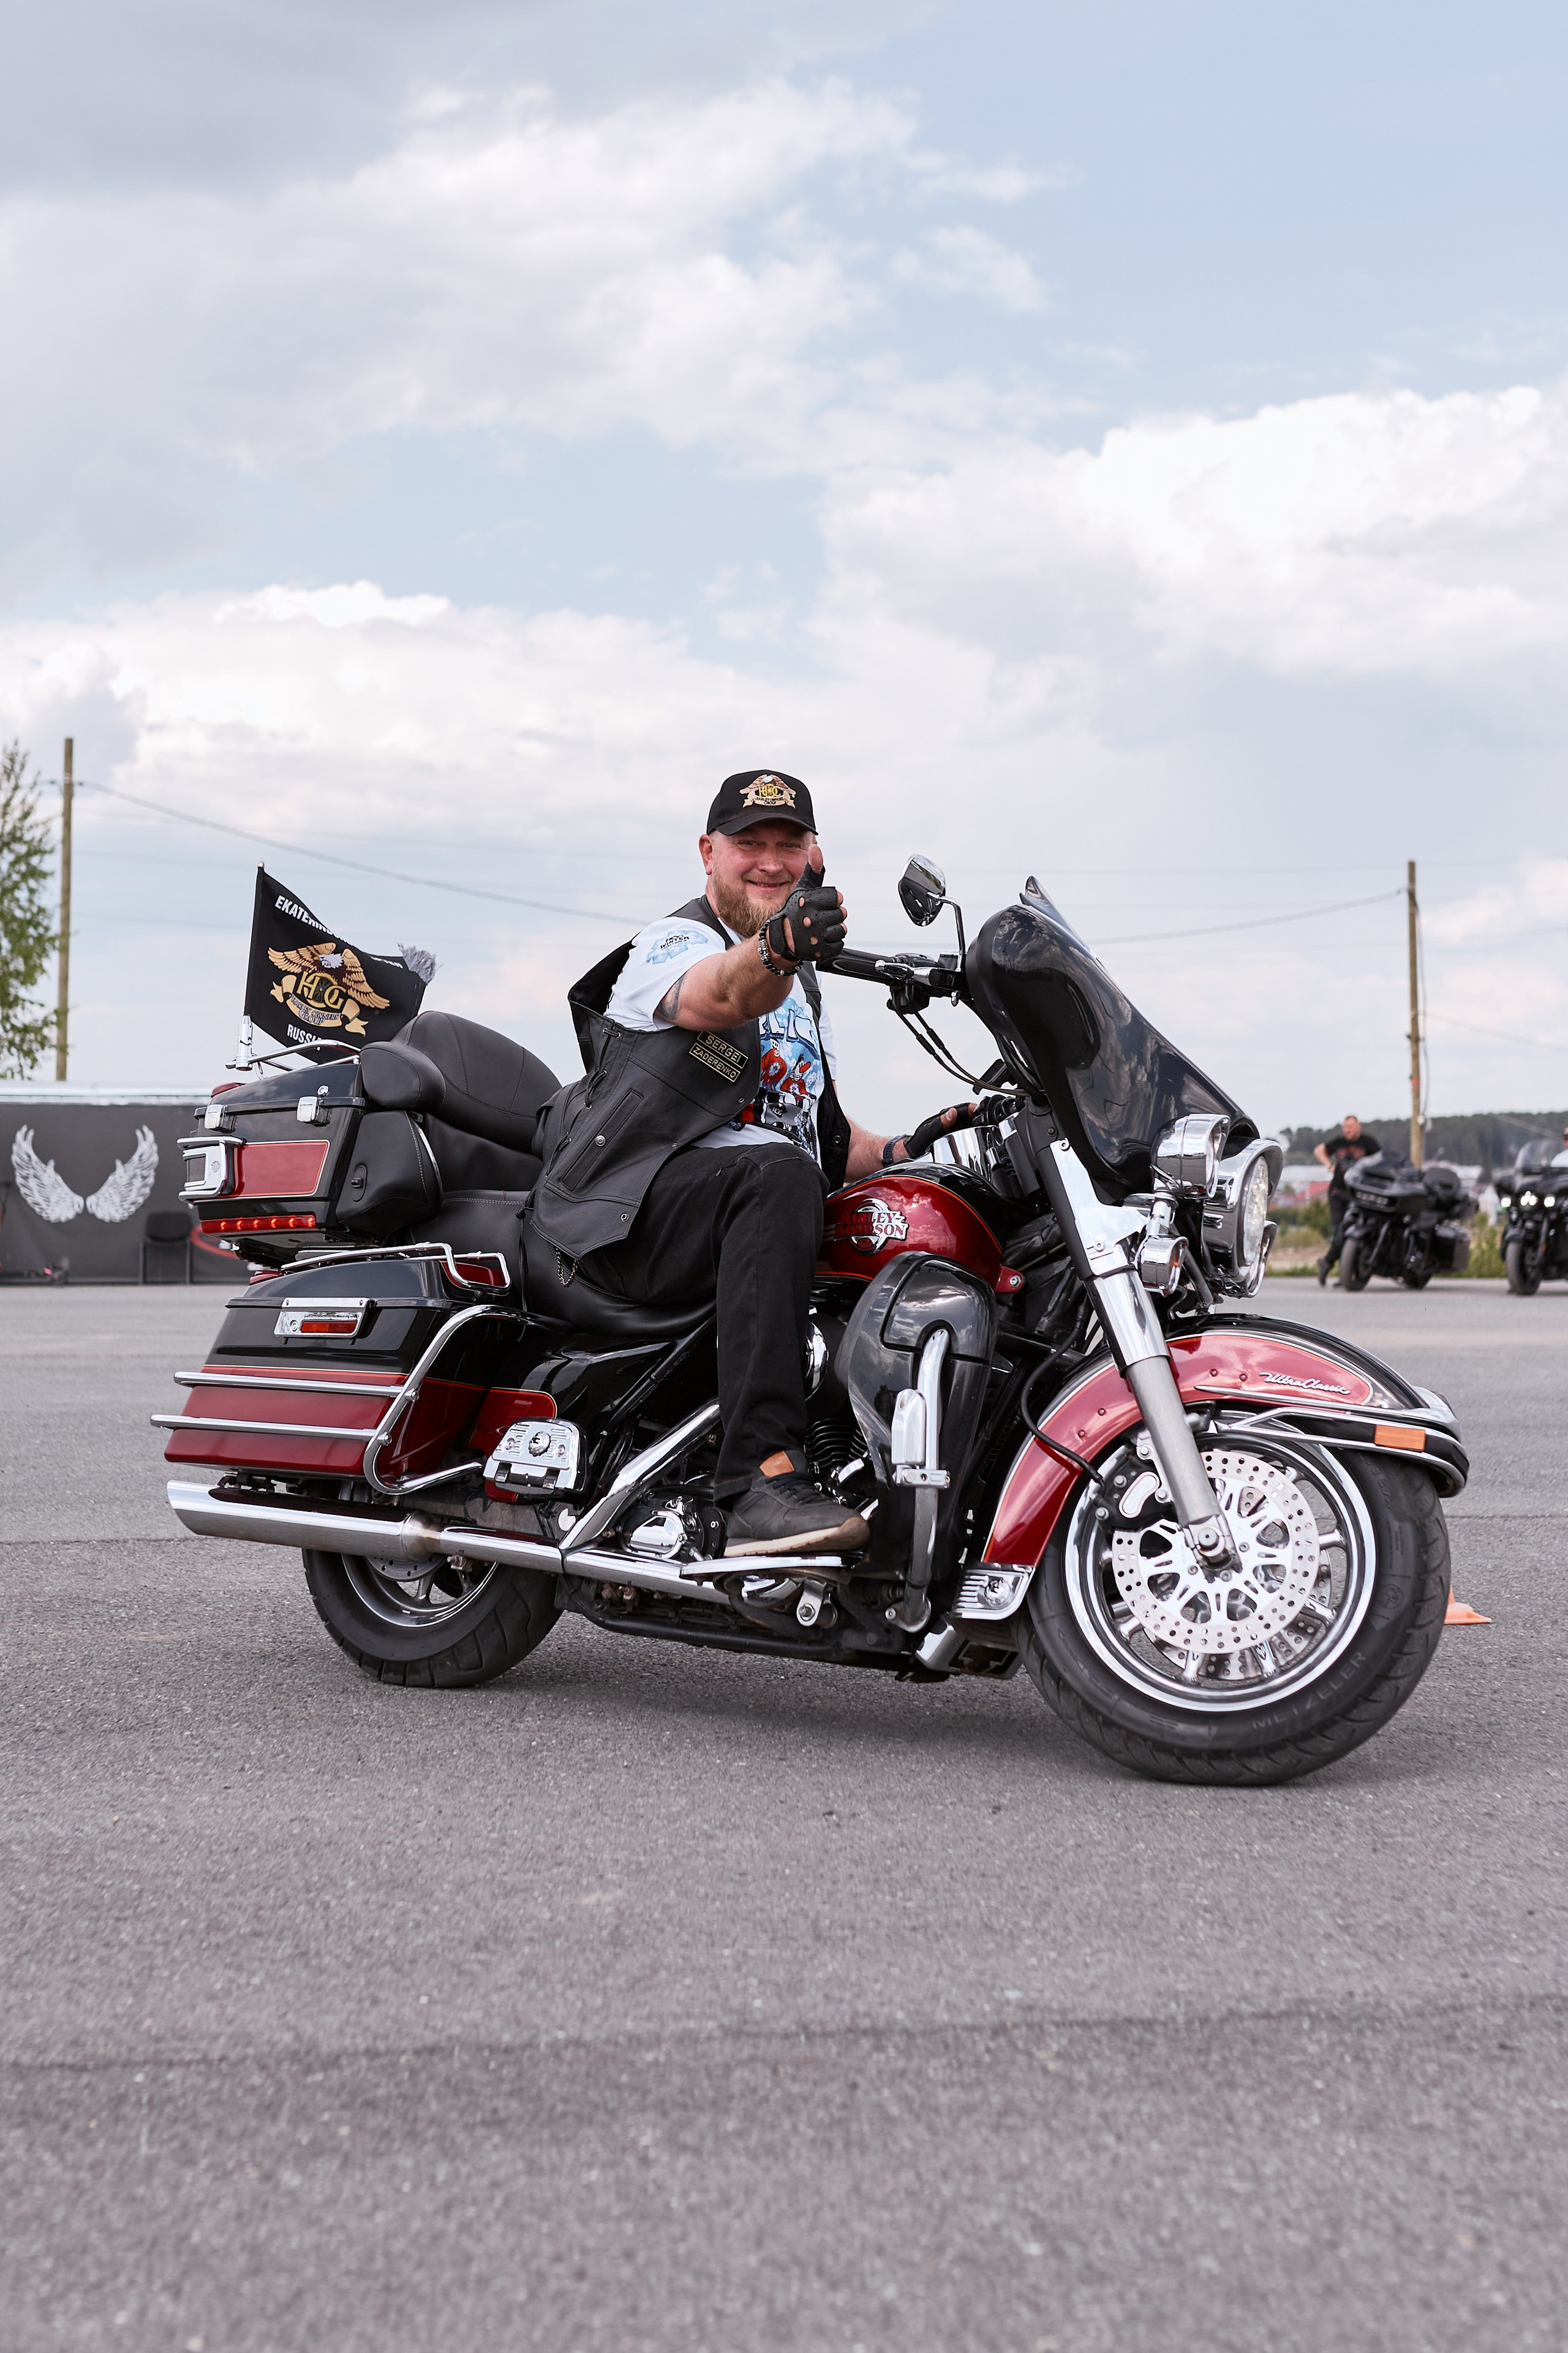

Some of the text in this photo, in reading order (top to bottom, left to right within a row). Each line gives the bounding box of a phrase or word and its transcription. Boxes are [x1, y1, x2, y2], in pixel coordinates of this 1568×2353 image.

[298, 1009, 325, 1025] GROUP
[312, 1010, 339, 1021] OWNERS
[287, 1024, 322, 1044] RUSS
[706, 1035, 742, 1063] SERGEI
[693, 1046, 737, 1079] ZADERENKO
